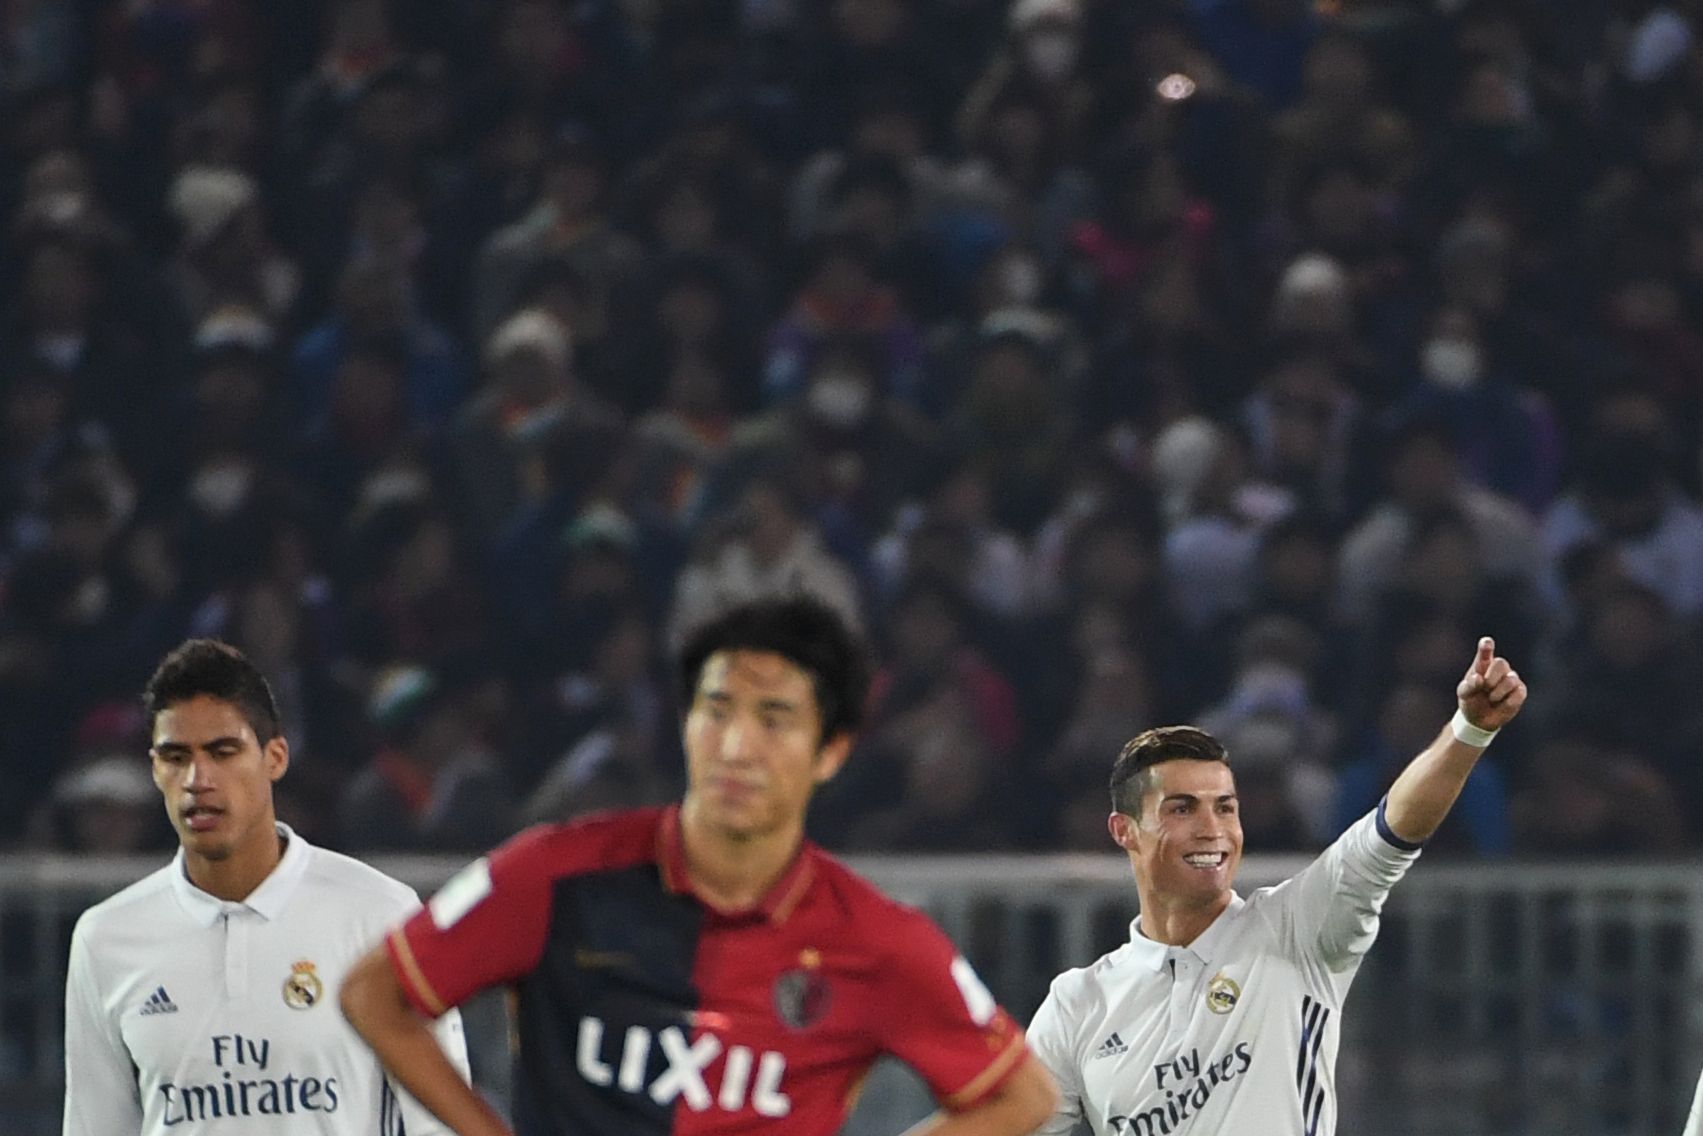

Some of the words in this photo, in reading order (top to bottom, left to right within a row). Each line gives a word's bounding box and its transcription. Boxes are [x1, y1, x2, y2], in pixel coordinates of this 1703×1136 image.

[211, 1033, 269, 1070] Fly
[576, 1016, 792, 1118] LIXIL
[1154, 1047, 1200, 1090] Fly
[159, 1070, 339, 1126] Emirates
